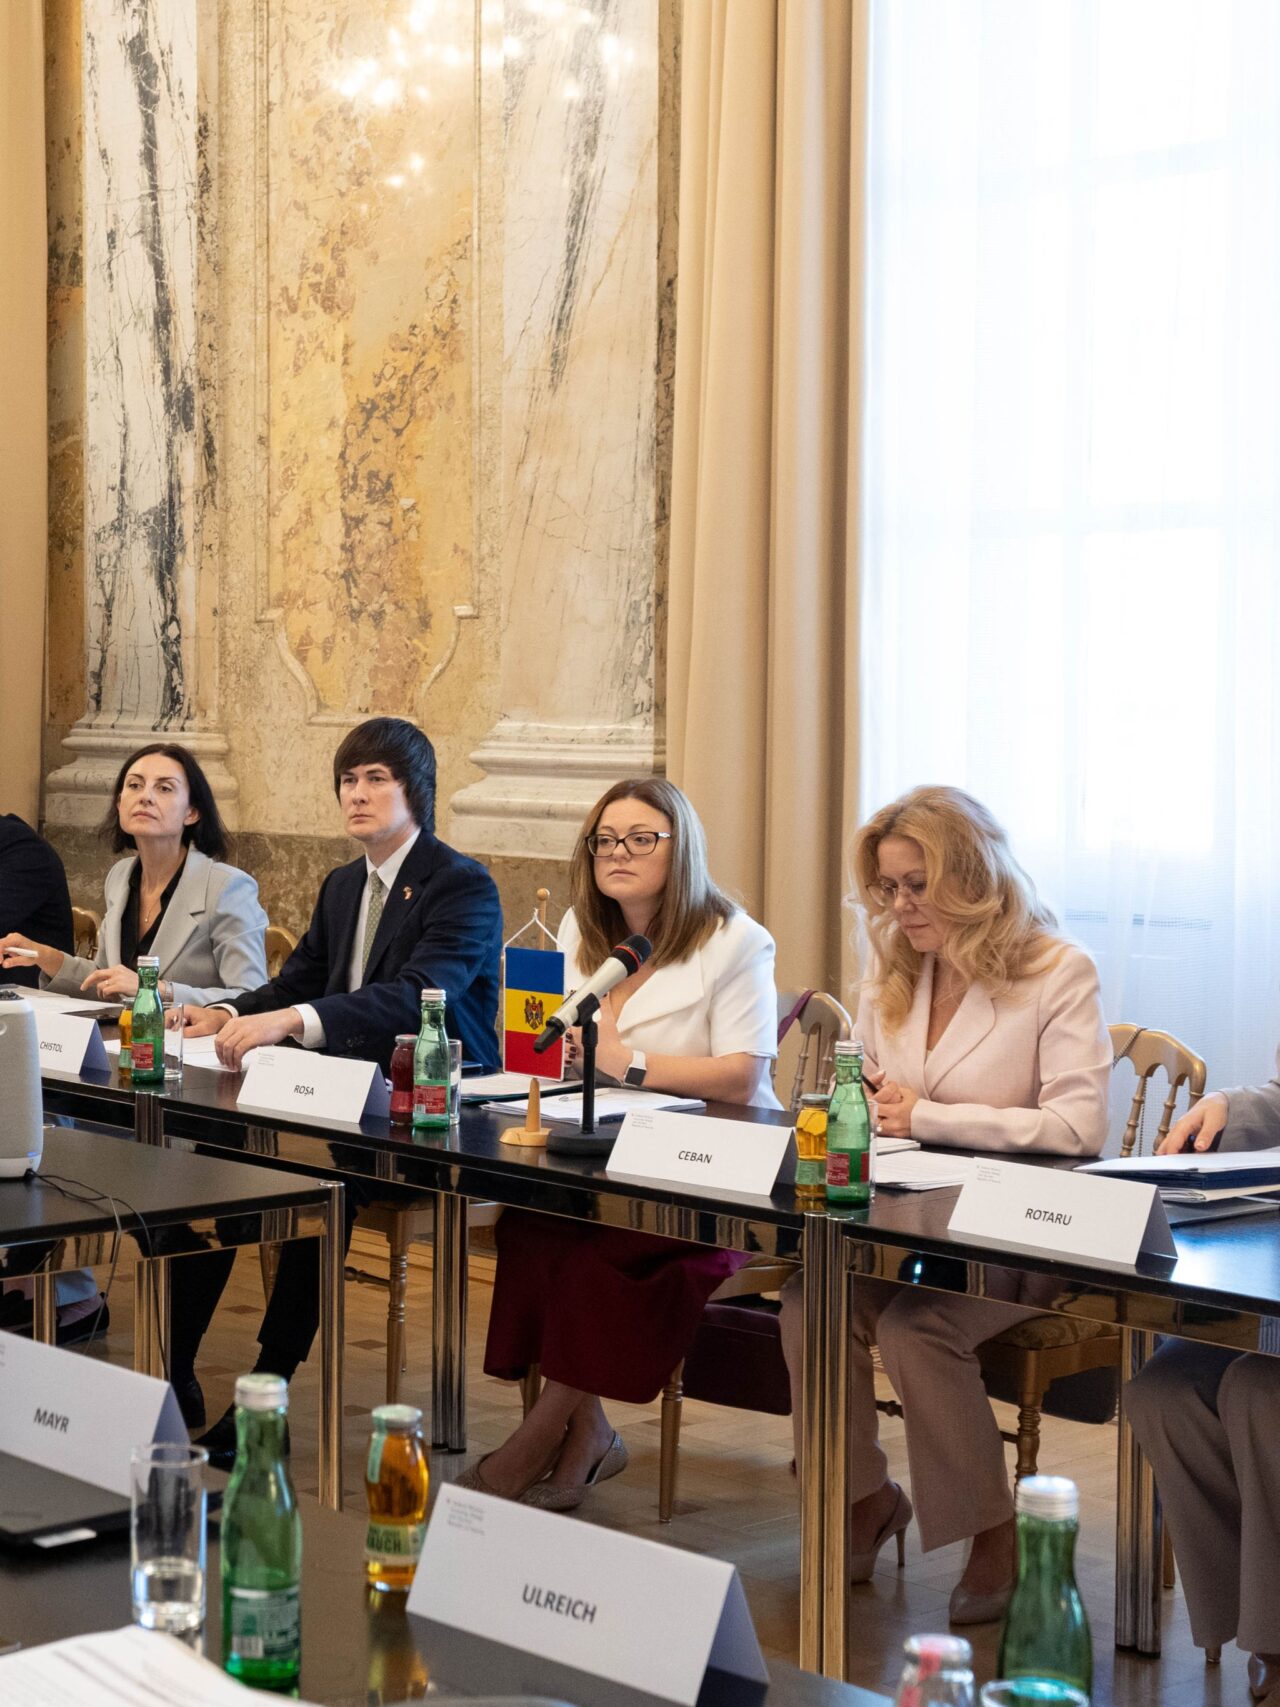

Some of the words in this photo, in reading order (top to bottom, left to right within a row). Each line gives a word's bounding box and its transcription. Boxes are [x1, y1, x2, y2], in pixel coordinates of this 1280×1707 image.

[678, 1150, 713, 1164] CEBAN
[1025, 1207, 1073, 1226] ROTARU
[33, 1407, 71, 1433] MAYR
[522, 1583, 598, 1625] ULREICH
